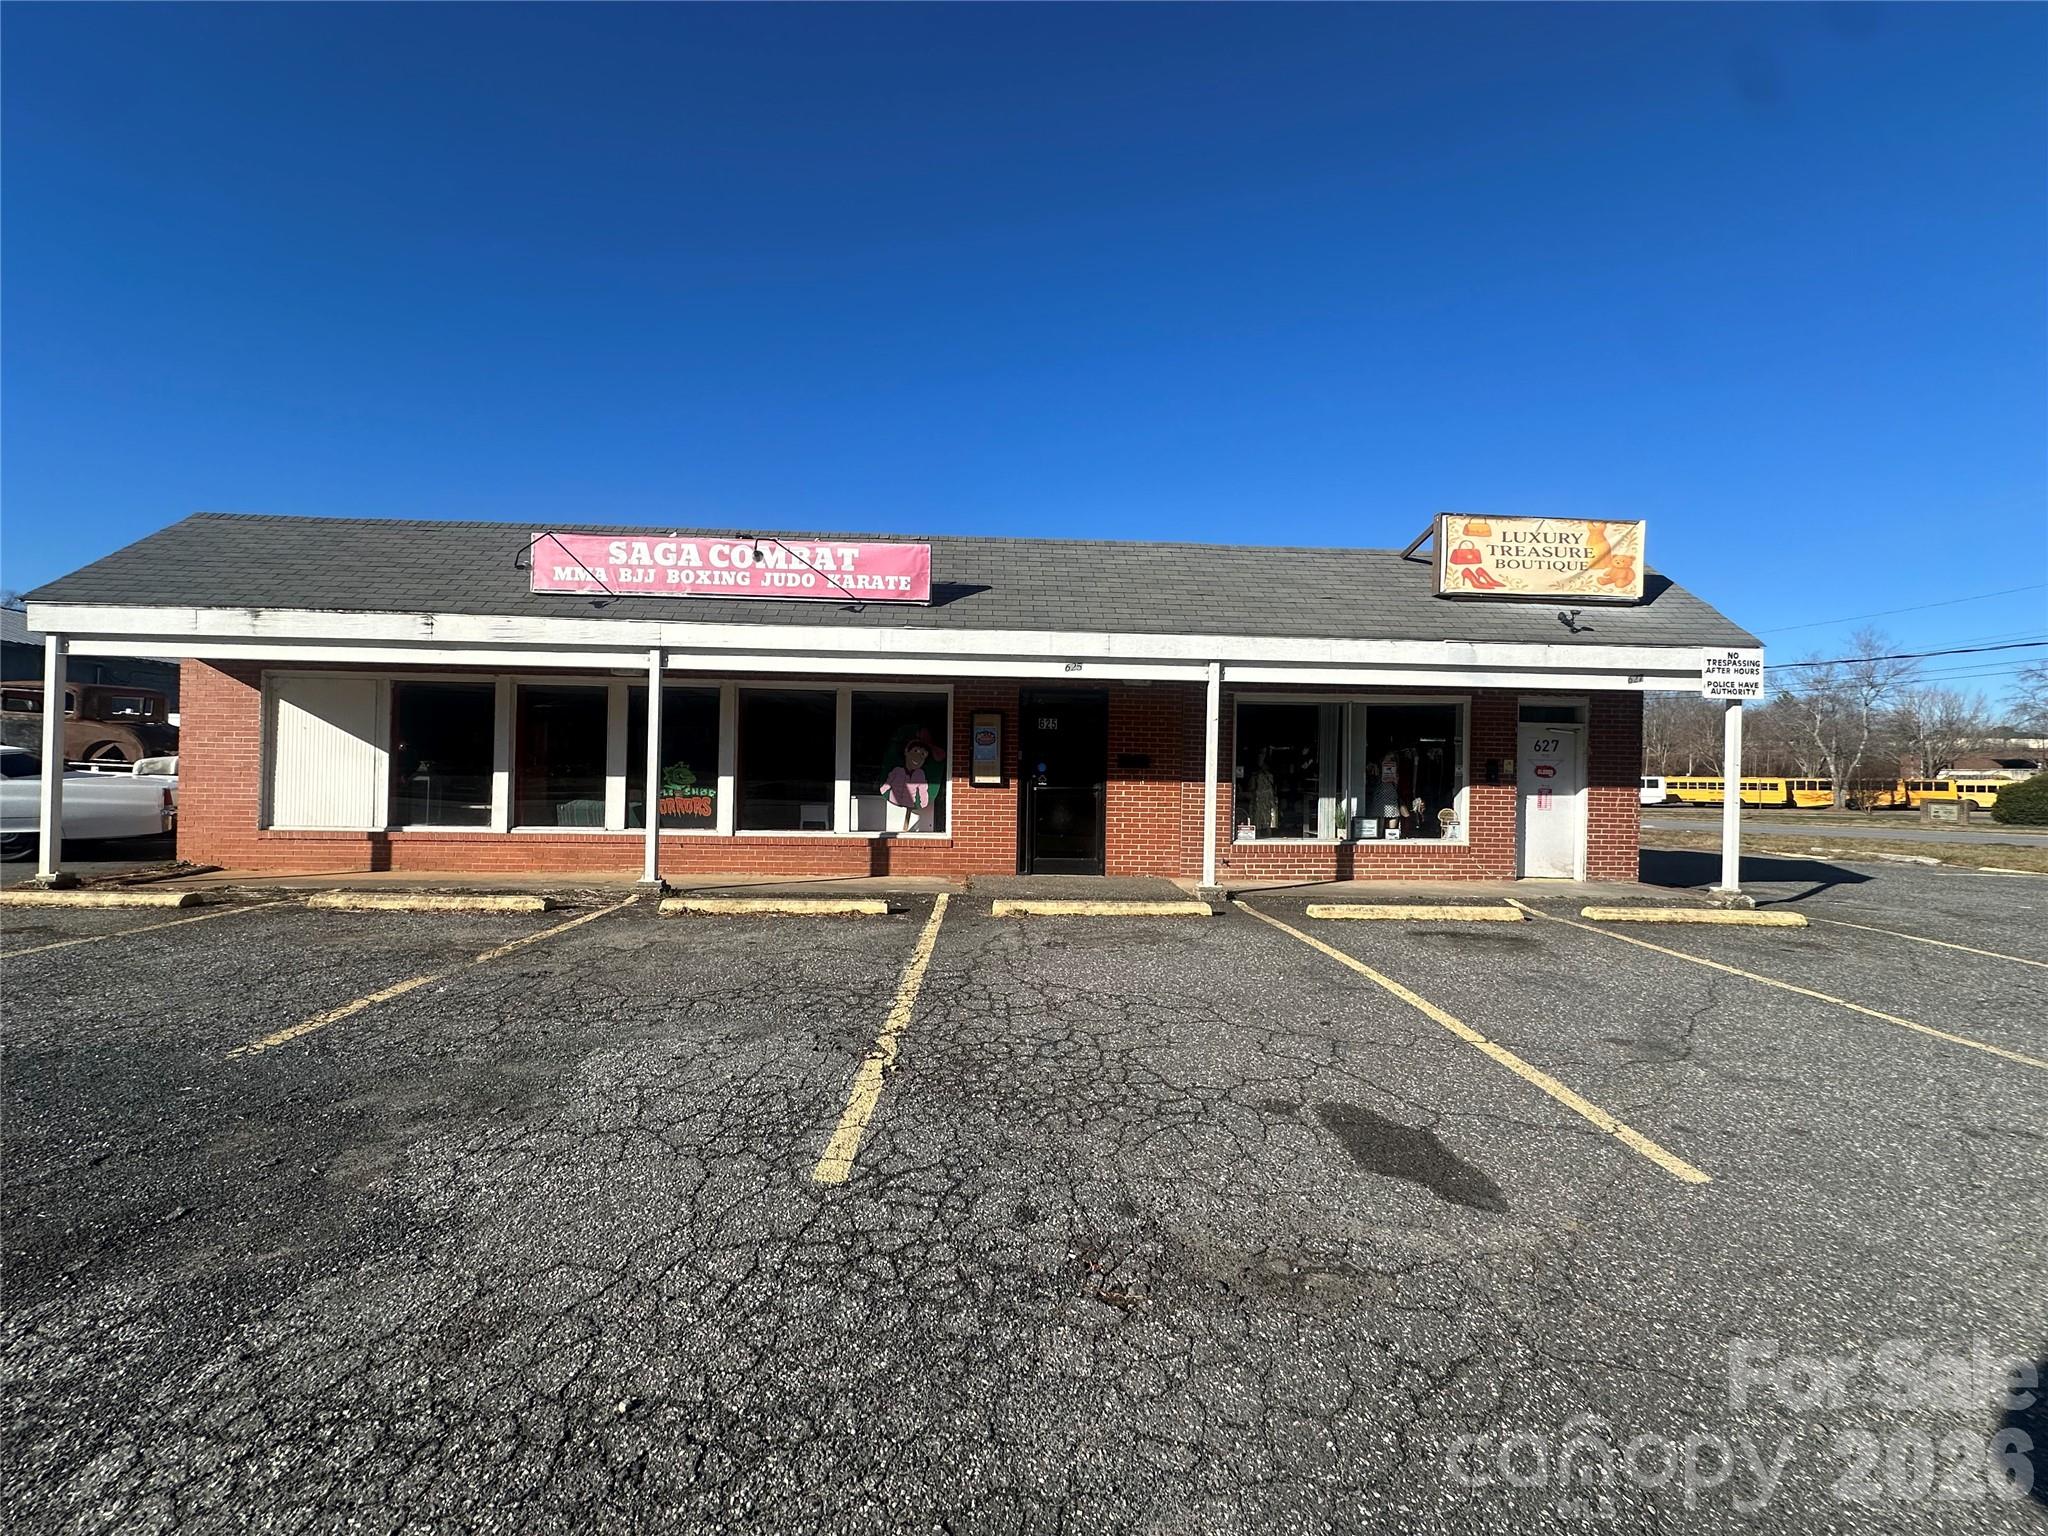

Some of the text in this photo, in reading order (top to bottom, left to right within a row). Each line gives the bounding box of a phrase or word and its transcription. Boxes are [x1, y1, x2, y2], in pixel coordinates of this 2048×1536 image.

[1502, 531, 1583, 545] LUXURY
[608, 540, 860, 572] SAGA COMBAT
[1486, 544, 1596, 559] TREASURE
[1495, 559, 1588, 573] BOUTIQUE
[552, 566, 912, 591] MMA BJJ BOXING JUDO KARATE
[1727, 651, 1740, 660] NO
[1065, 663, 1083, 672] 625
[1706, 658, 1761, 668] TRESPASSING
[1733, 667, 1760, 675] HOURS
[1706, 680, 1760, 689] POLICE HAVE
[1039, 718, 1057, 729] 625
[1533, 739, 1559, 752] 627
